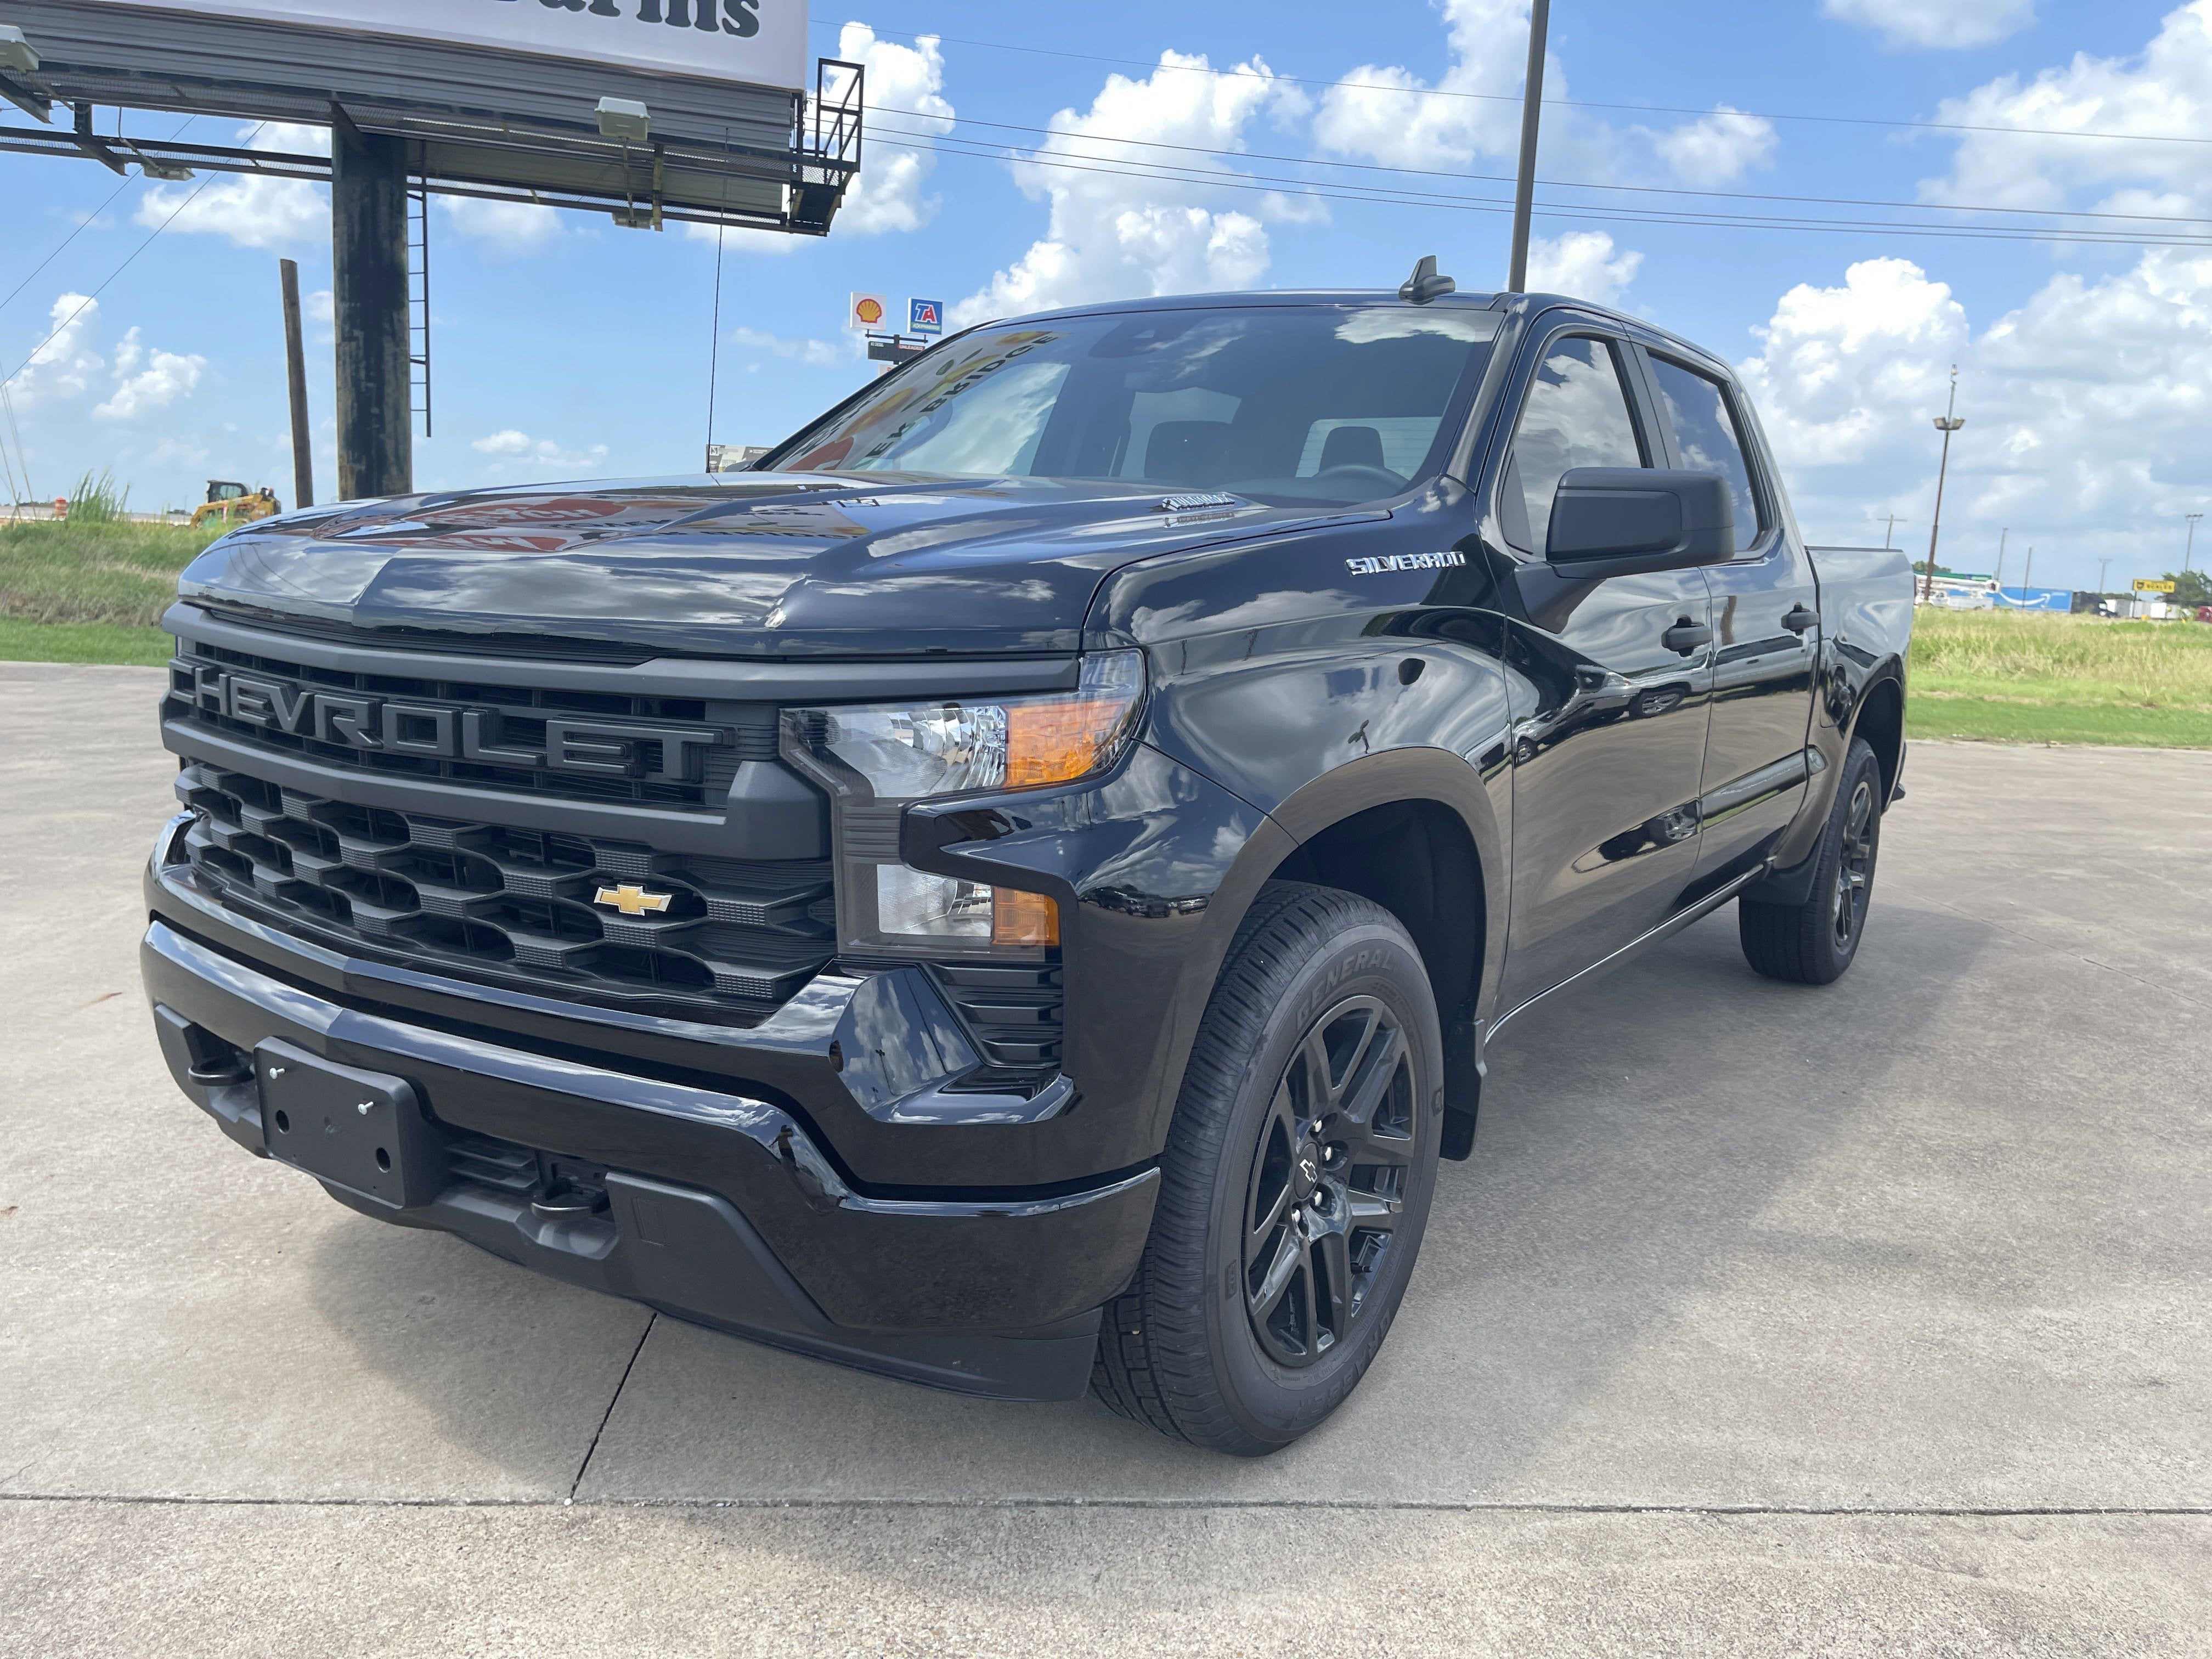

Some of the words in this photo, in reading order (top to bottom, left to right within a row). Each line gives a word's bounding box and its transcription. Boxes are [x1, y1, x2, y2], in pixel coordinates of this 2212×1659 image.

[915, 303, 937, 324] TA
[1345, 551, 1467, 576] SILVERADO
[169, 658, 734, 781] CHEVROLET
[1295, 948, 1394, 1031] GENERAL
